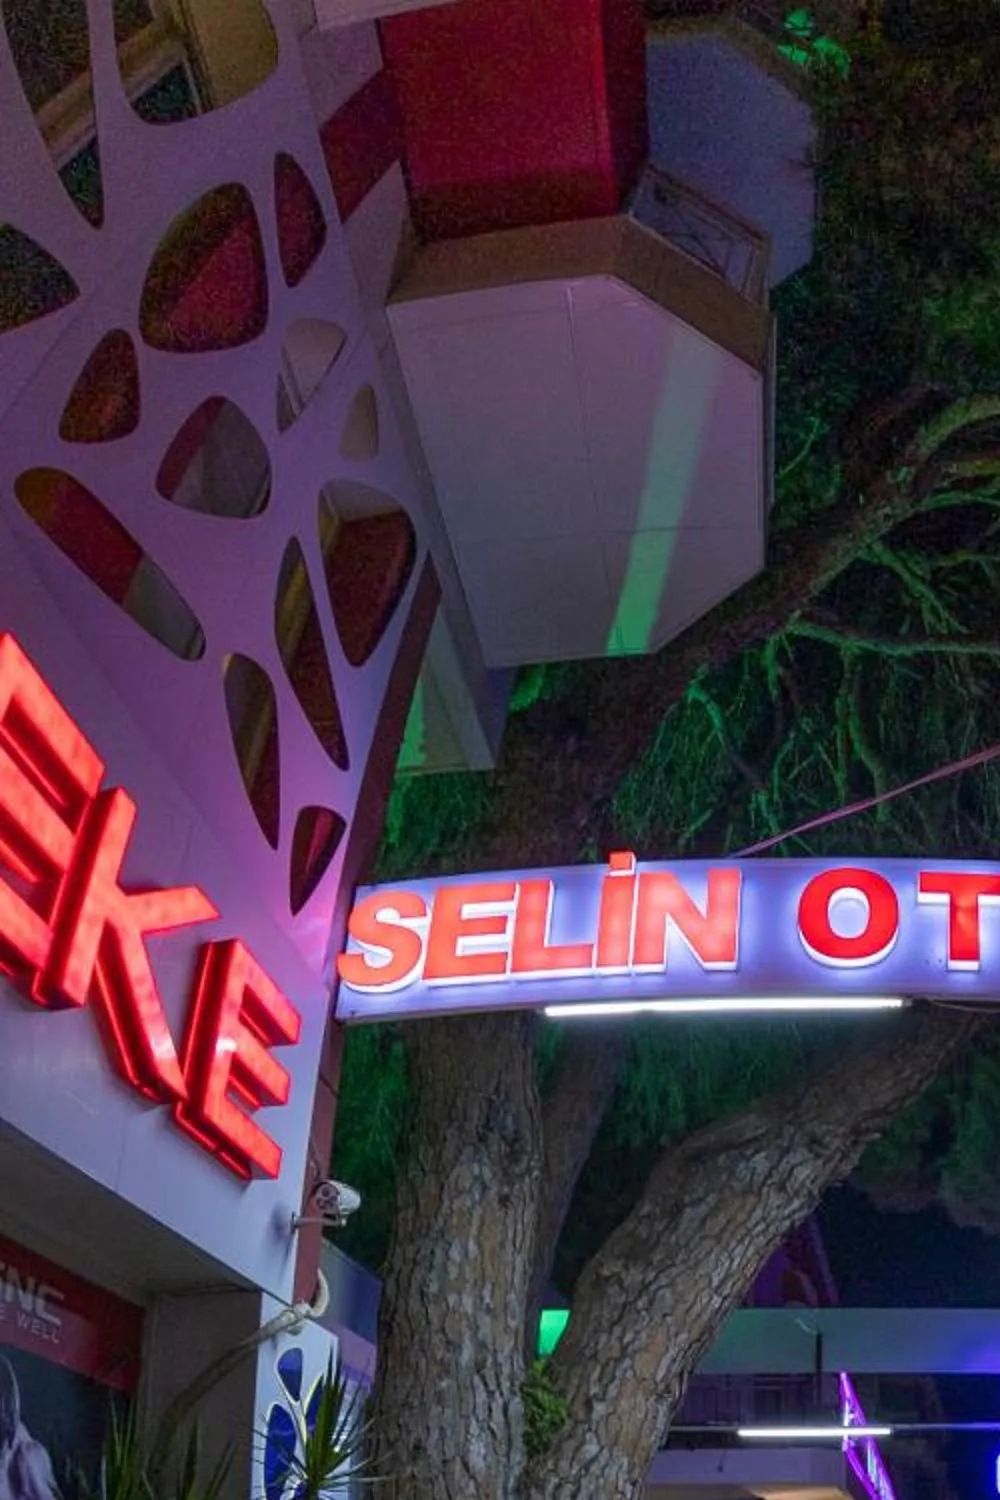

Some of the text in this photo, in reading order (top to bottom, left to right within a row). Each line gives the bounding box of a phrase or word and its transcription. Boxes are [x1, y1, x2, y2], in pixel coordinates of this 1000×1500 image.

[0, 631, 302, 1180] EKE
[337, 851, 742, 993] SELİN
[0, 1260, 65, 1326] NC
